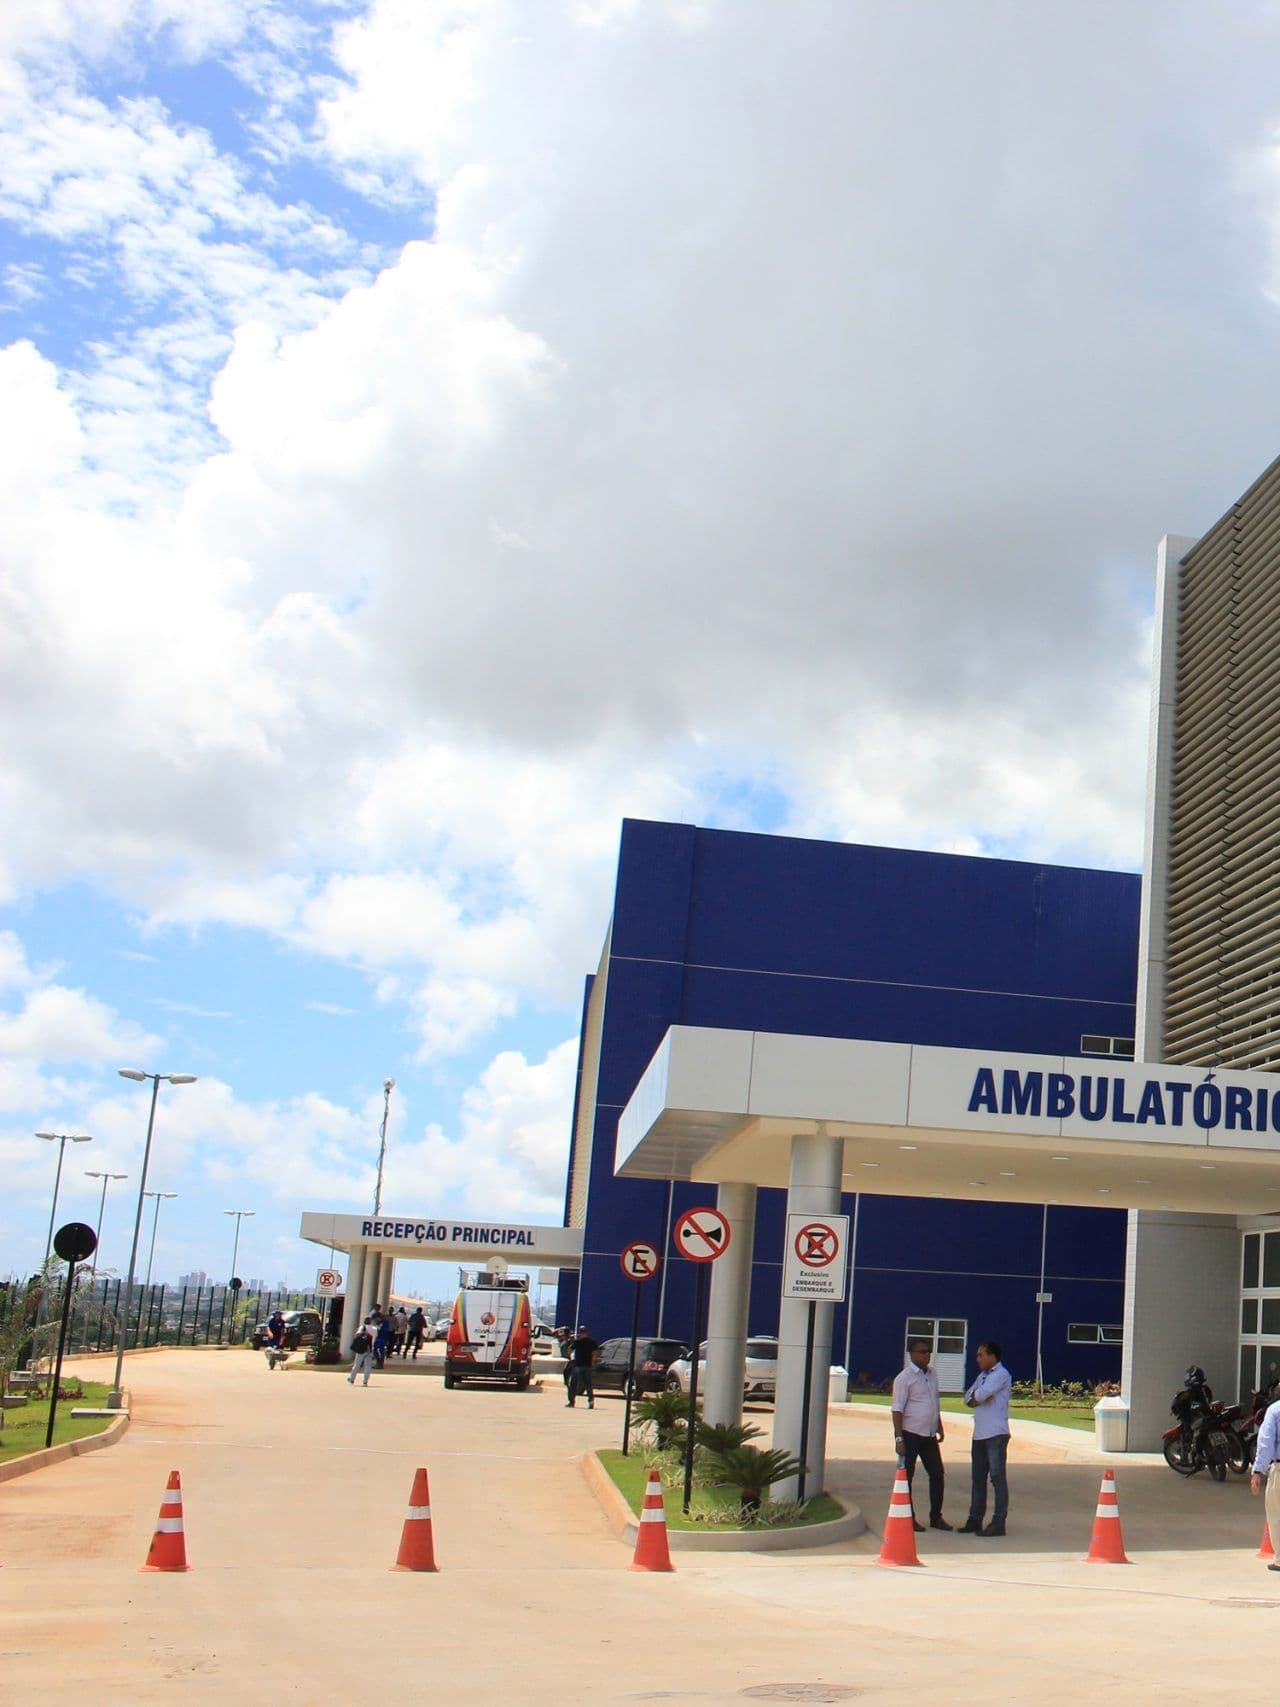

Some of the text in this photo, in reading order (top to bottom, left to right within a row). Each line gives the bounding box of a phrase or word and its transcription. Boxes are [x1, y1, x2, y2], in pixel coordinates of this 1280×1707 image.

[362, 1221, 535, 1246] RECEPÇÃO PRINCIPAL
[795, 1279, 827, 1287] EMBARQUE
